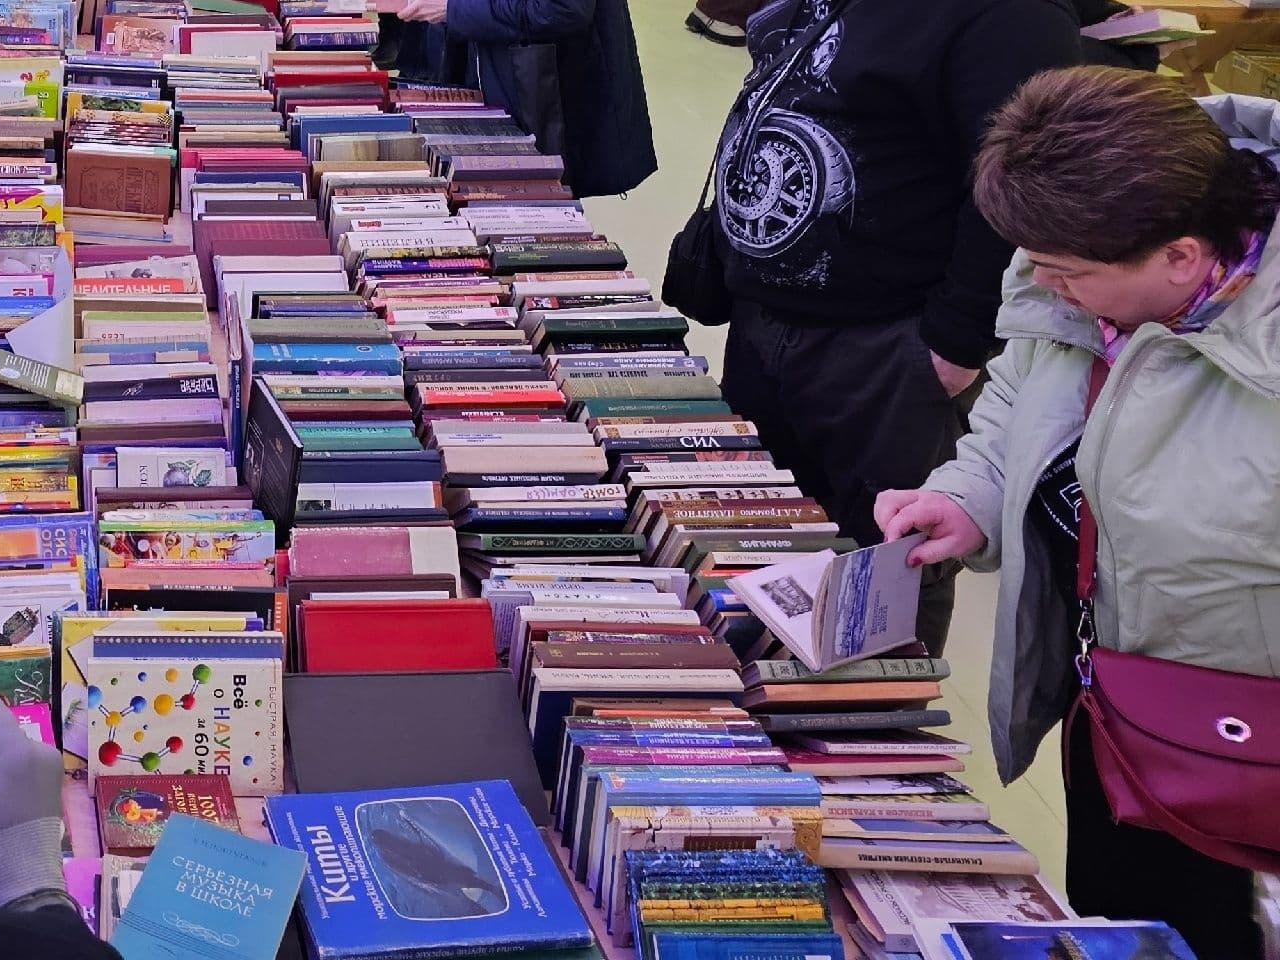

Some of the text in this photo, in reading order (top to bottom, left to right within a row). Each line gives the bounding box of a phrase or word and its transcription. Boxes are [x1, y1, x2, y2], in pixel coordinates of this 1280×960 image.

[526, 488, 577, 500] ОДИССЕЯ
[673, 508, 734, 520] ПАМЯТНОЕ
[233, 674, 248, 709] Всё
[195, 733, 209, 757] 60
[214, 707, 230, 775] НАУКЕ
[269, 686, 277, 784] БЫСТРАЯ НАУКА
[886, 809, 934, 818] НЕКРАСОВ
[306, 826, 356, 903] Киты
[334, 805, 388, 920] морские млекопитающие
[337, 843, 356, 873] другие
[173, 856, 274, 899] СЕРЬЁЗНАЯ
[181, 871, 256, 907] МУЗЫКА
[176, 882, 255, 918] В ШКОЛЕ
